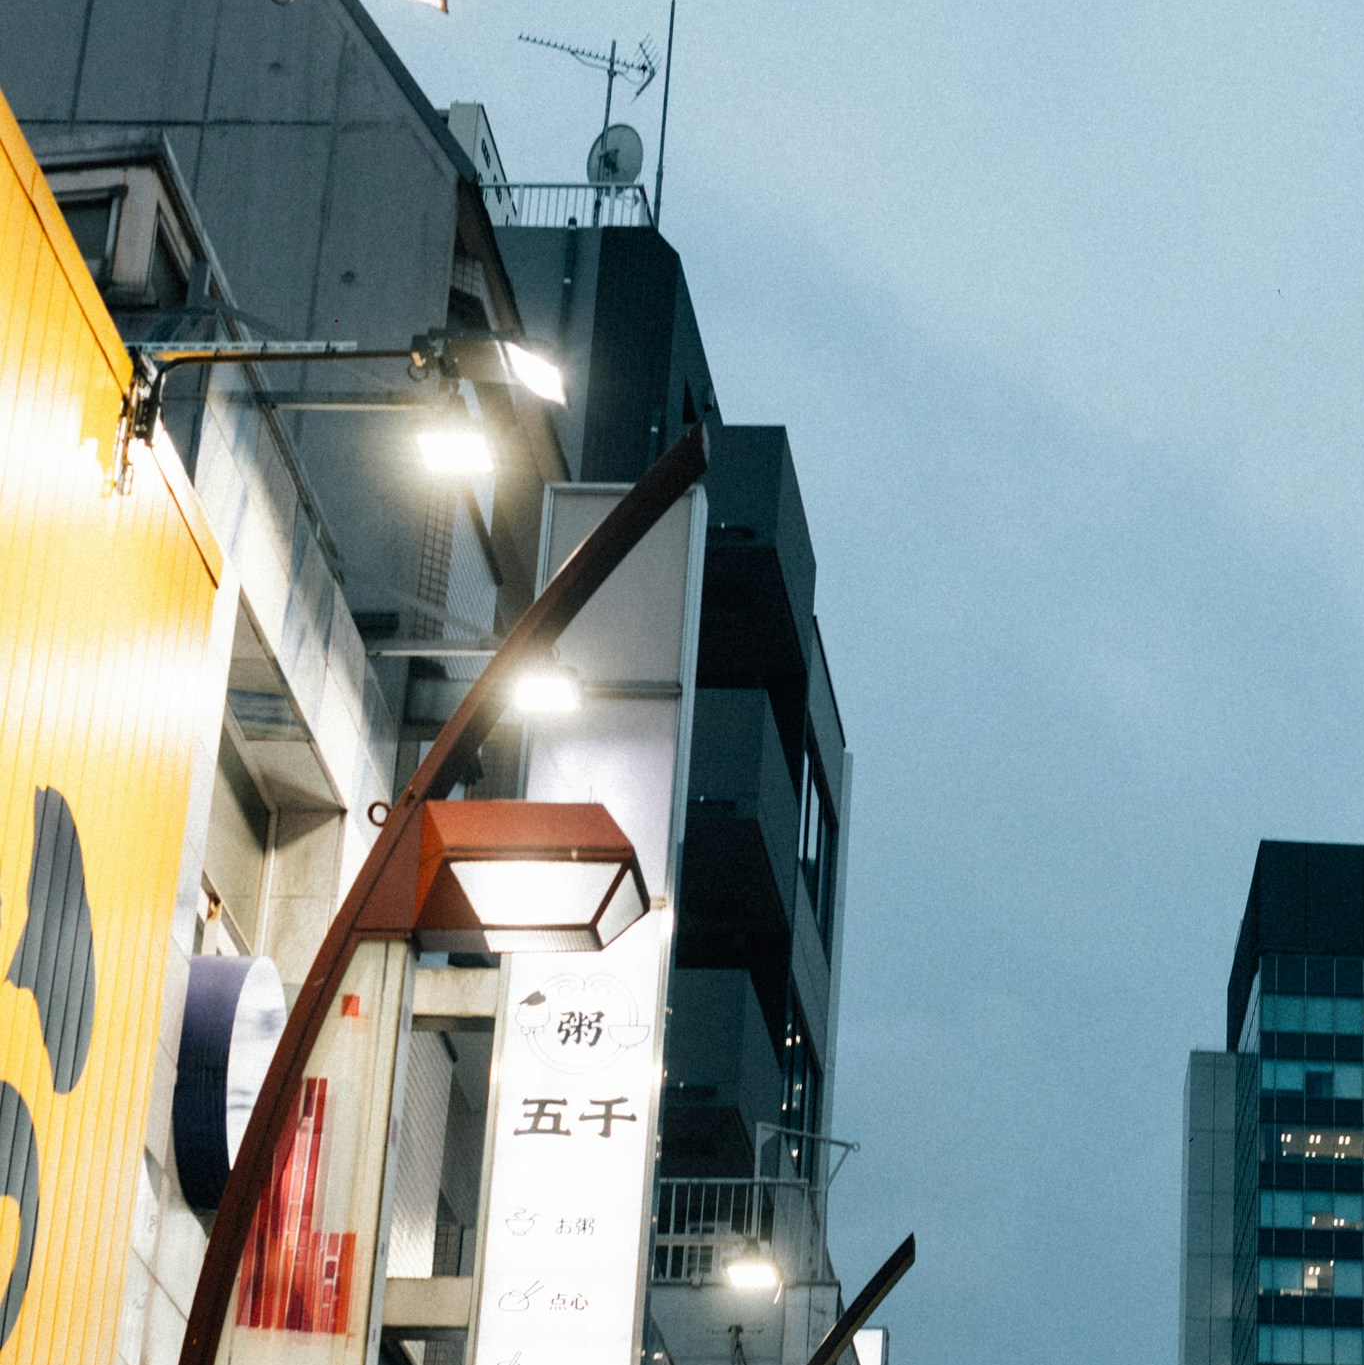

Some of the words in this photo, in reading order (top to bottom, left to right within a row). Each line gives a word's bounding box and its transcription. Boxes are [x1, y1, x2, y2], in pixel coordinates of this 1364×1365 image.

[557, 1010, 605, 1047] 粥
[513, 1096, 637, 1138] 五千
[555, 1217, 595, 1235] お粥
[549, 1292, 589, 1311] 点心
